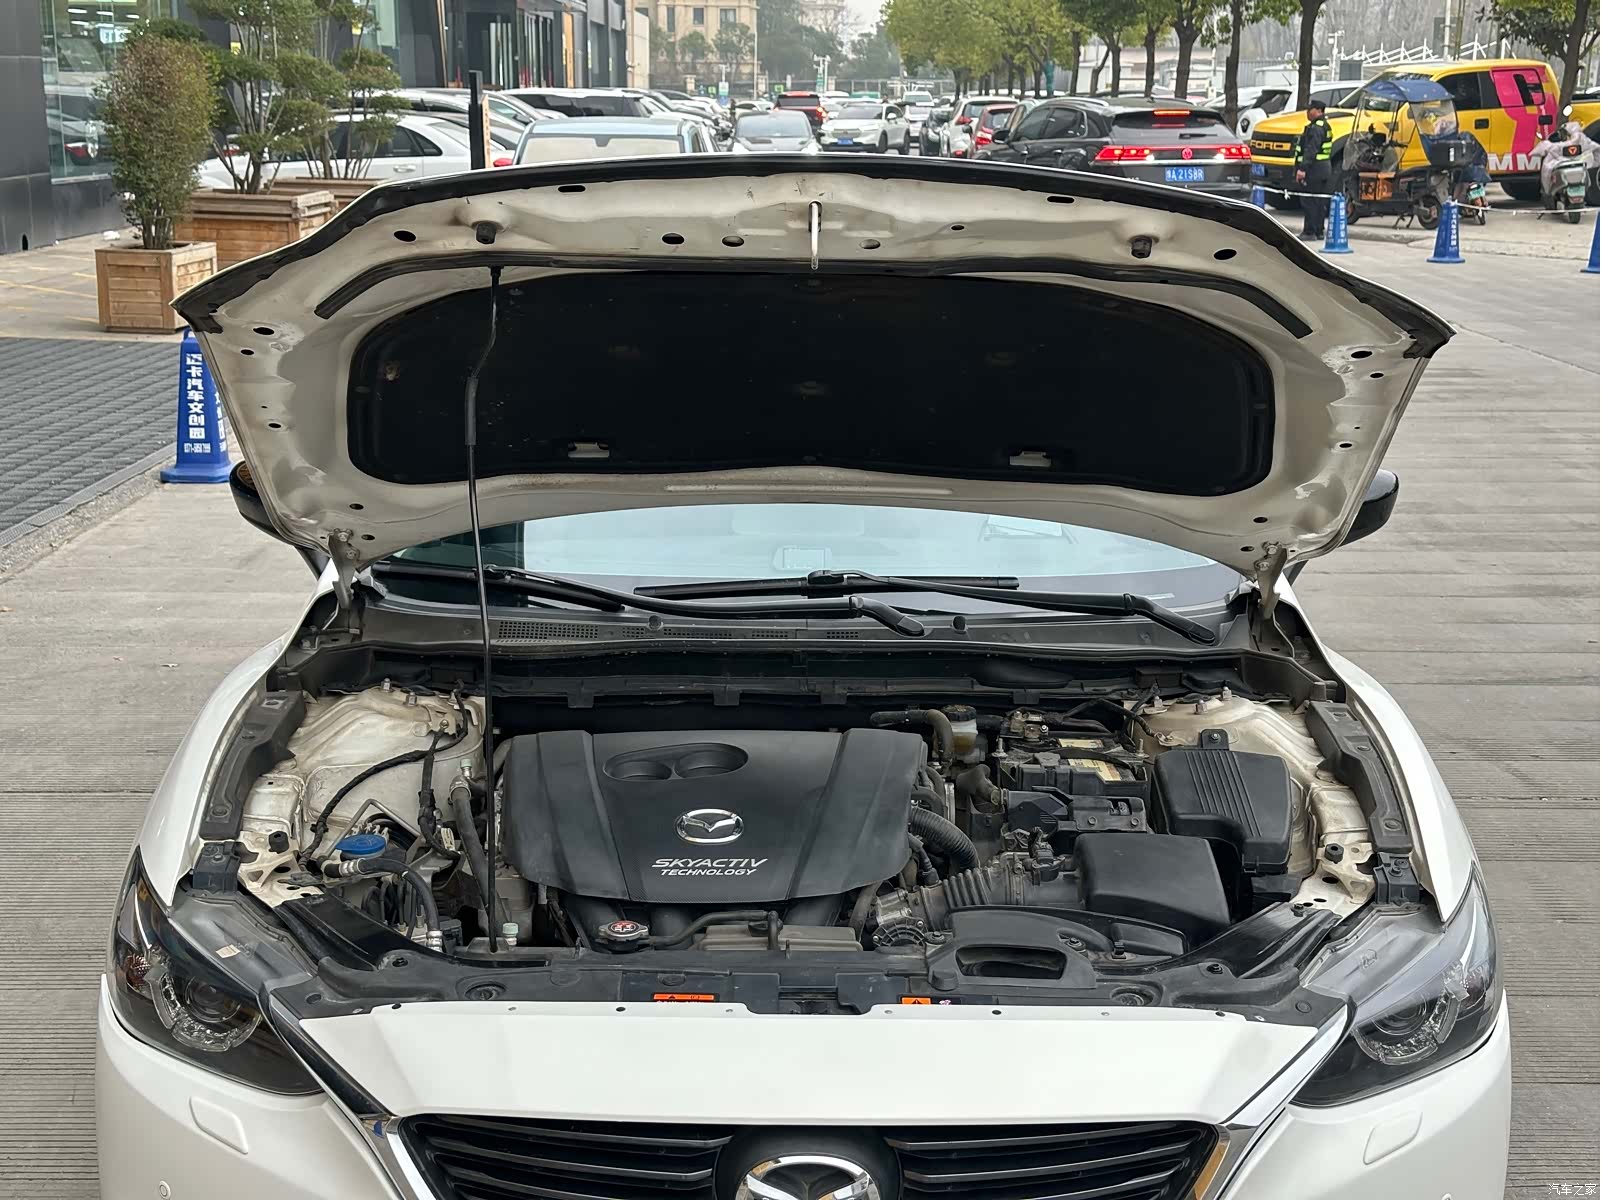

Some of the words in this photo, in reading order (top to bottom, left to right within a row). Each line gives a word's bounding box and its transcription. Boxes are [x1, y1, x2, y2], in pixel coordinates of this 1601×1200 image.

[1250, 140, 1291, 151] FORD
[652, 858, 768, 868] SKYACTIV
[660, 868, 757, 876] TECHNOLOGY
